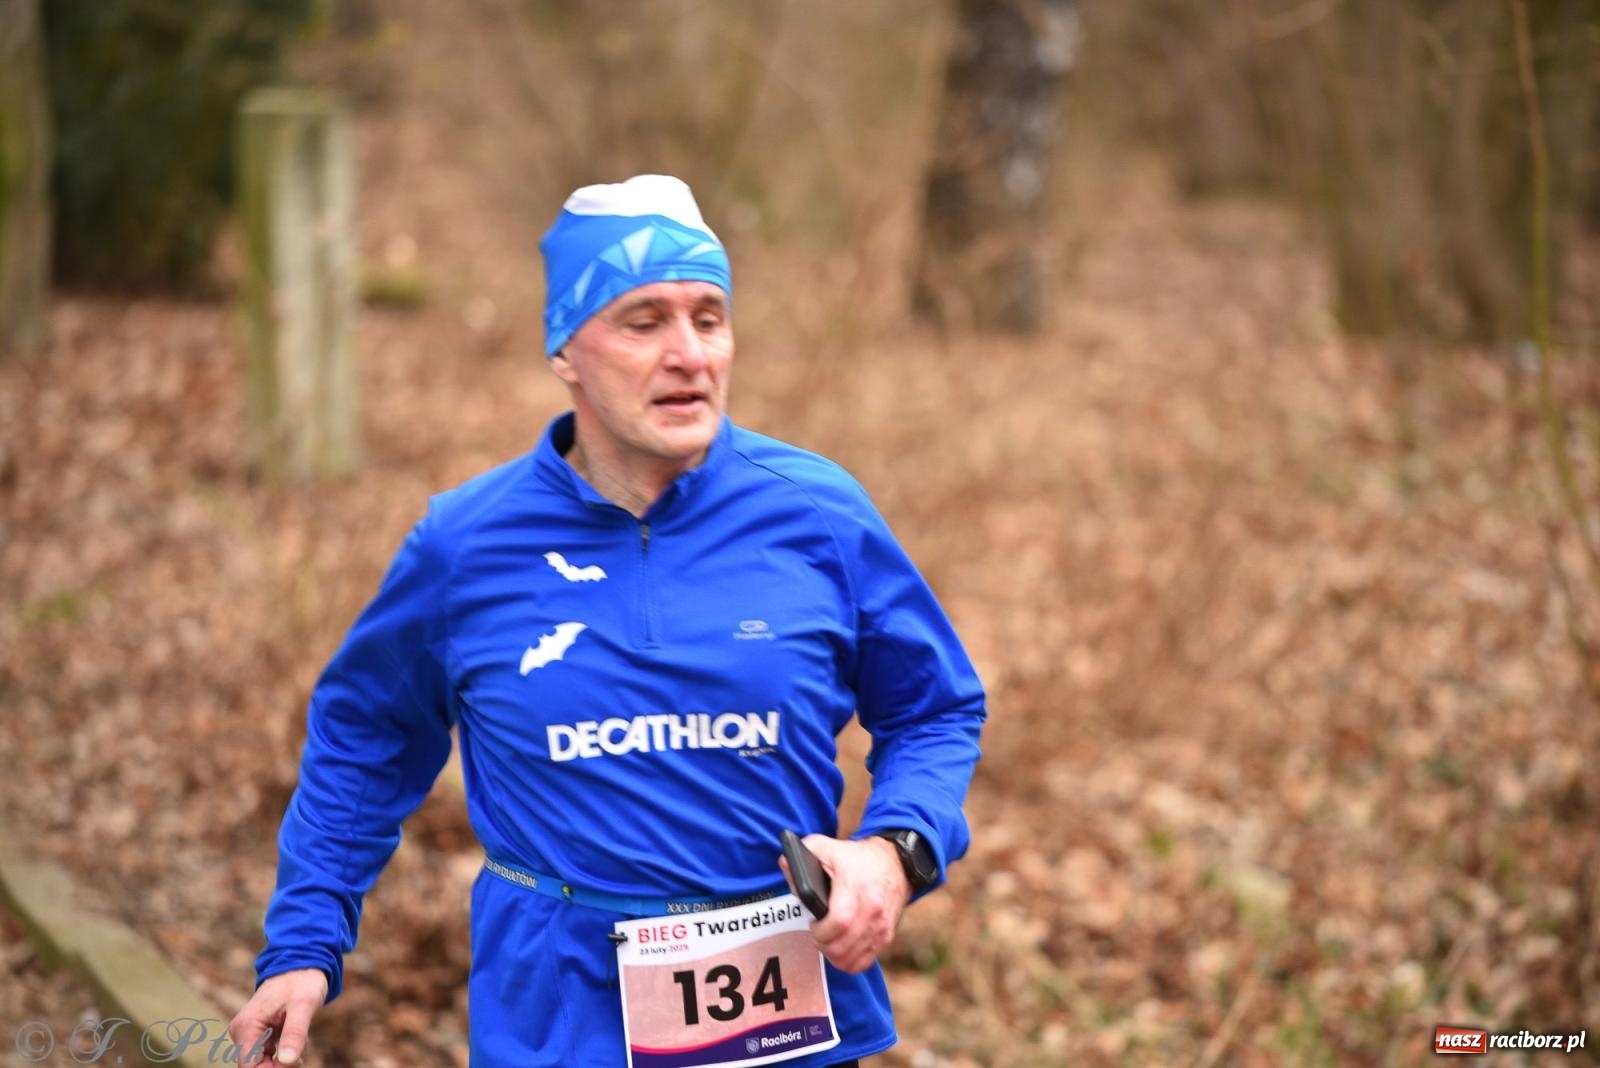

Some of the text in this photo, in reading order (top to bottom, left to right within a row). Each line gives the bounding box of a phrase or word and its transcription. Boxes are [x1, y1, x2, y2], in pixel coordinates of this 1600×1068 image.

[546, 711, 780, 762] DECATHLON
[637, 903, 802, 944] BIEG Twardziela
[667, 902, 690, 914] XXX
[673, 955, 788, 1026] 134
[761, 1030, 802, 1048] Racibórz
